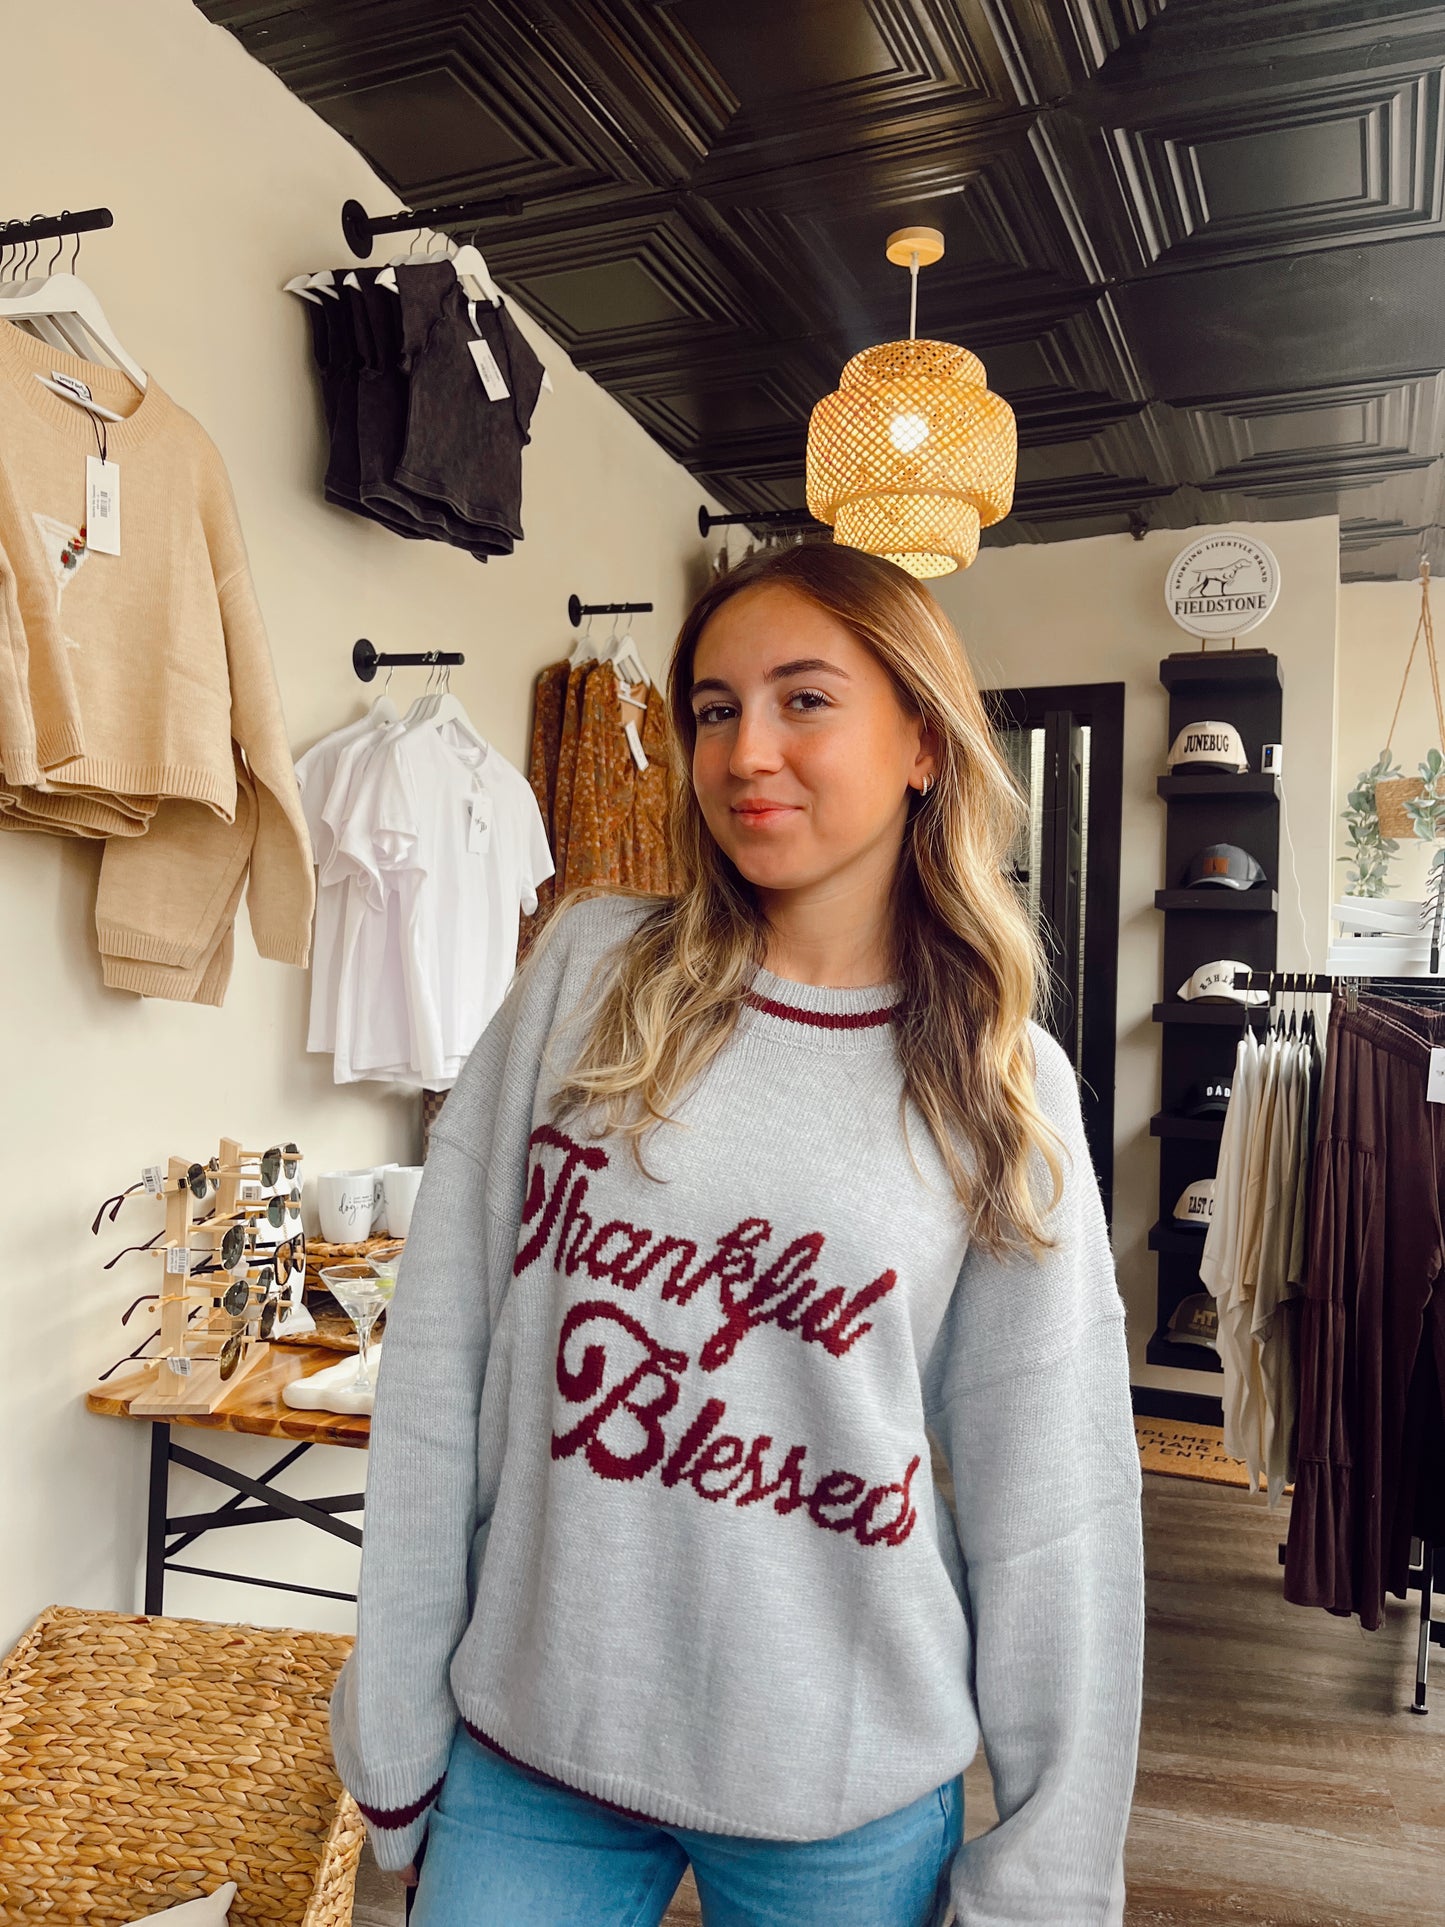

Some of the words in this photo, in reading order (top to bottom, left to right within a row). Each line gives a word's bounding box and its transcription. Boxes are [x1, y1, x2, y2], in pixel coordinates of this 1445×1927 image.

[1253, 554, 1268, 583] BRAND
[1174, 594, 1267, 615] FIELDSTONE
[1184, 734, 1229, 753] JUNEBUG
[551, 1300, 920, 1547] Blessed
[1149, 1438, 1211, 1452] HAIR
[1160, 1447, 1247, 1465] ENTRY
